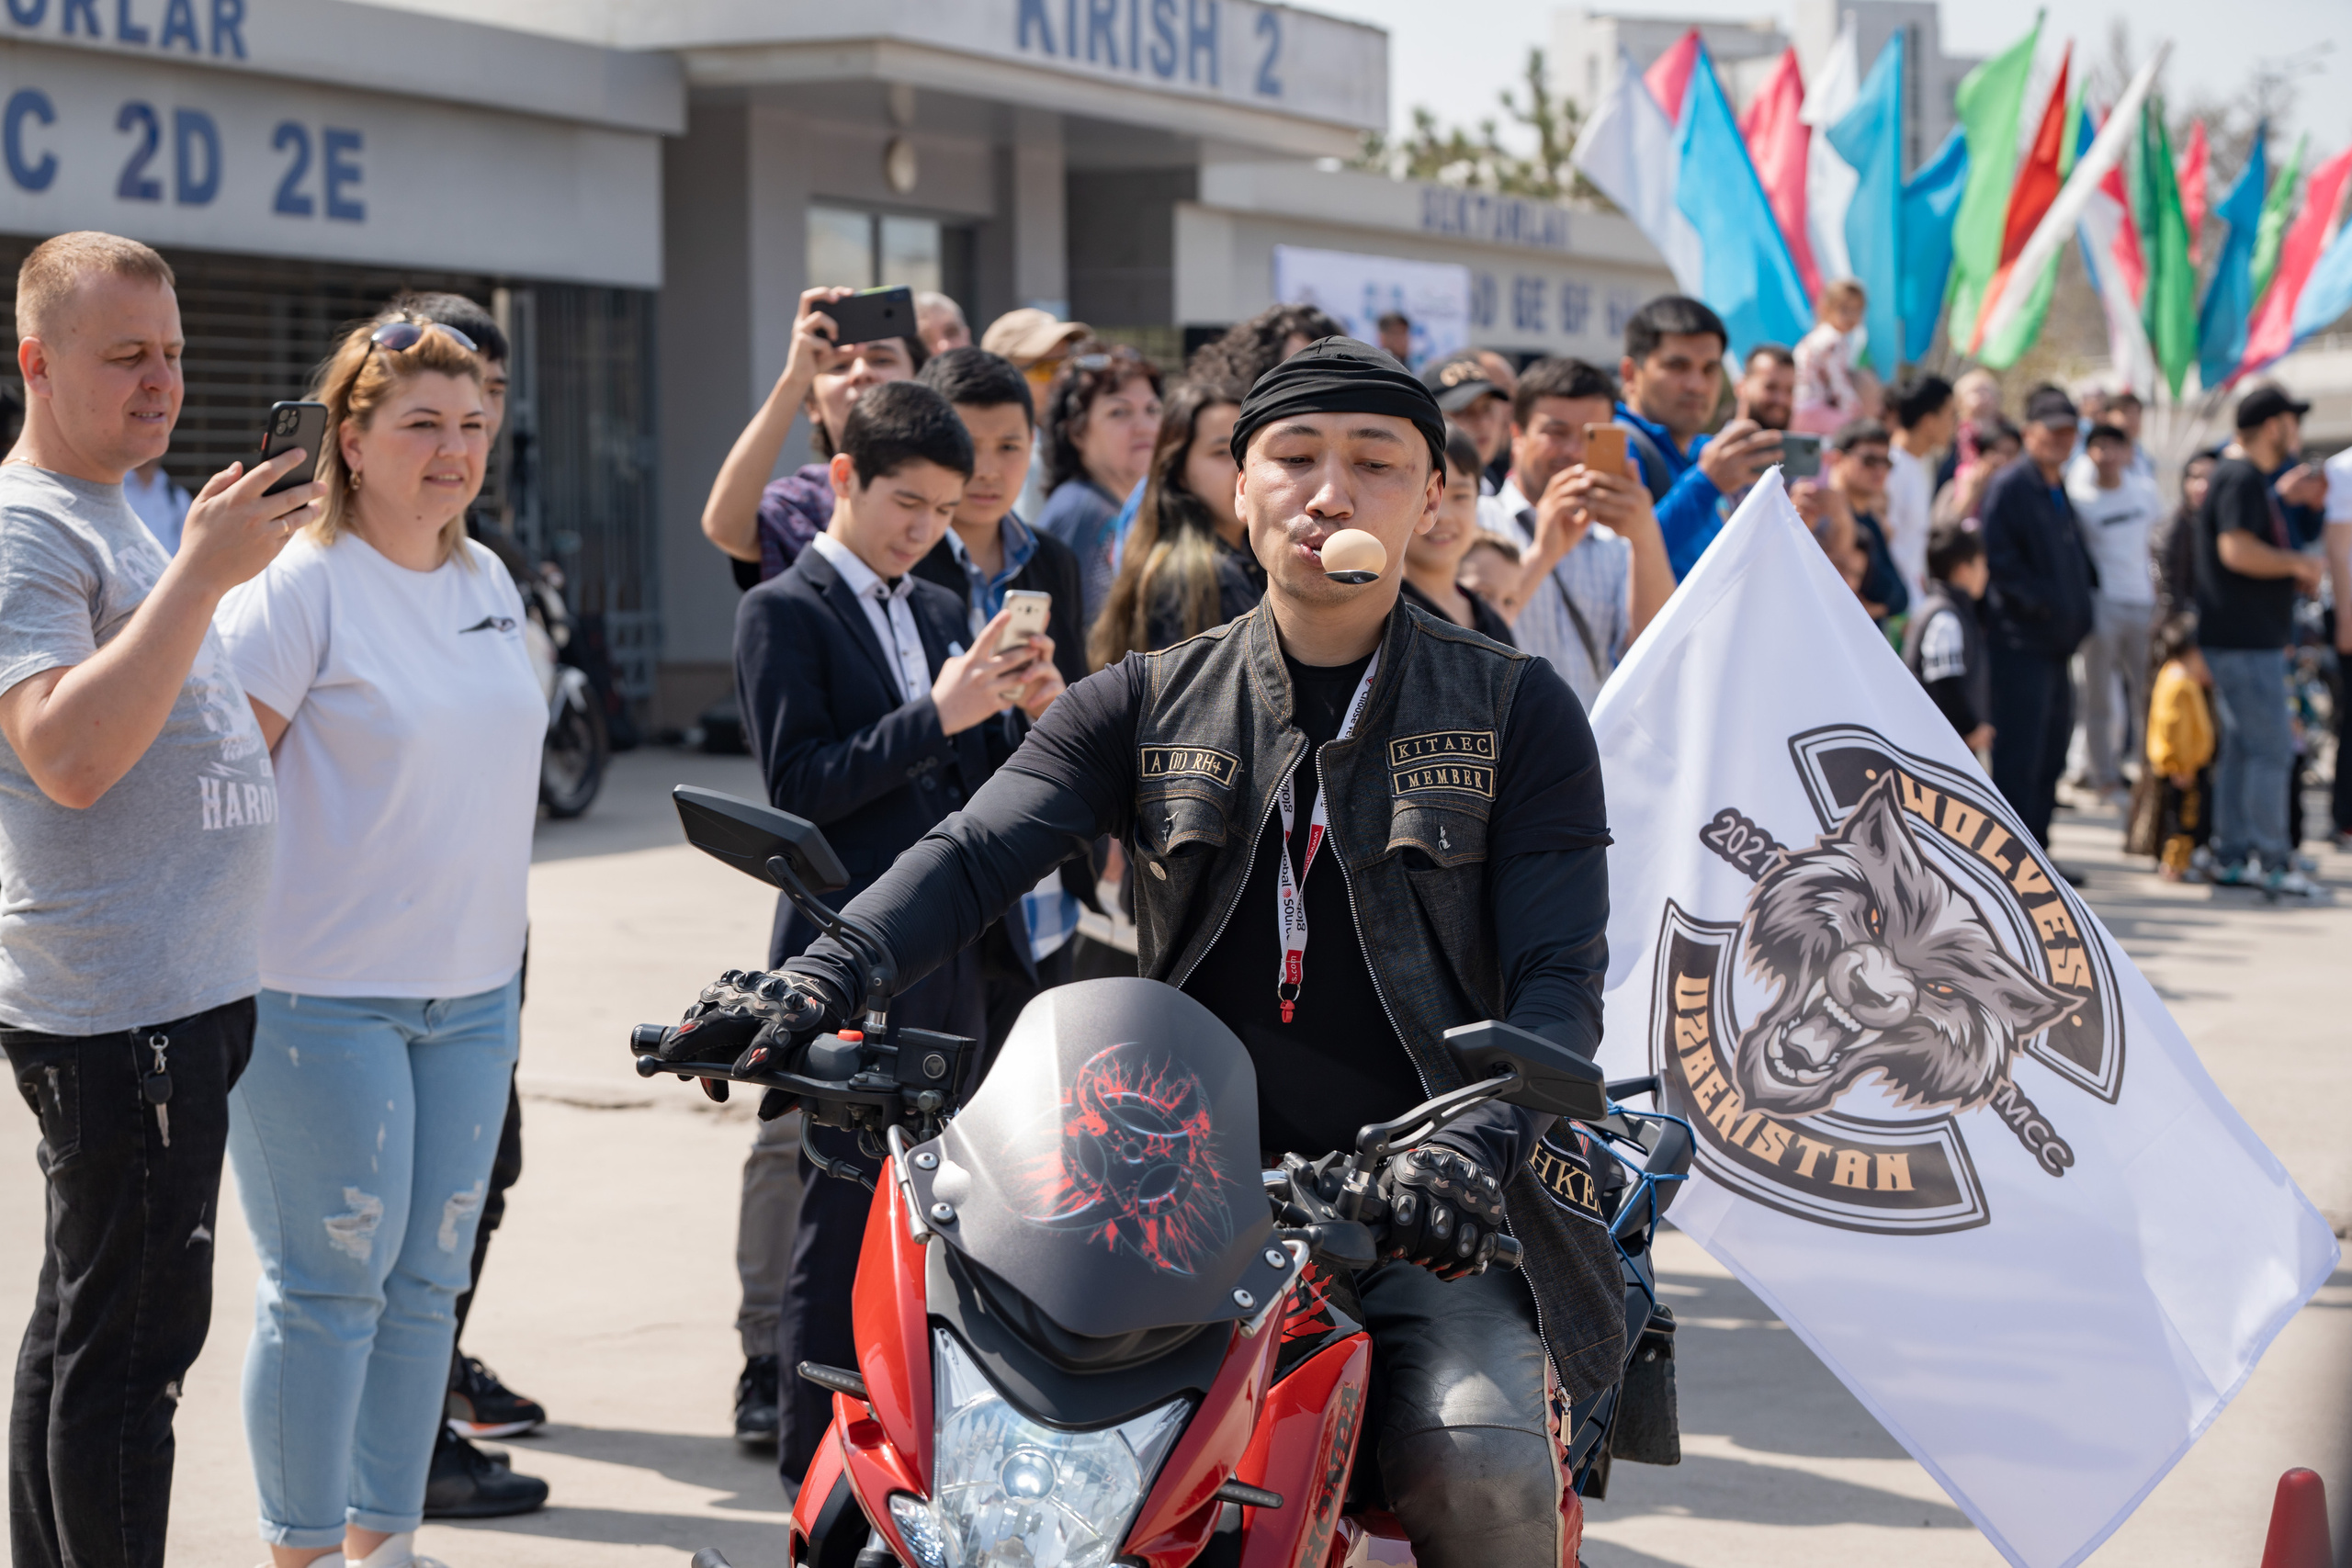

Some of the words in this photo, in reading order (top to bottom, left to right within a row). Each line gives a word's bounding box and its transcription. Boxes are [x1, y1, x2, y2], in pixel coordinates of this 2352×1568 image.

[1016, 0, 1220, 87] KIRISH
[1255, 11, 1283, 97] 2
[116, 100, 223, 207] 2D
[271, 120, 366, 222] 2E
[1150, 752, 1161, 772] A
[1396, 736, 1489, 759] KITAEC
[1408, 769, 1484, 789] MEMBER
[198, 775, 279, 830] HARD
[1708, 816, 1780, 875] 2021
[1896, 769, 2094, 992] WOLVES
[1675, 971, 1917, 1190] UZBEKISTAN
[1996, 1088, 2067, 1169] MCC
[1529, 1142, 1603, 1216] HKE
[1299, 1382, 1360, 1568] HONDA
